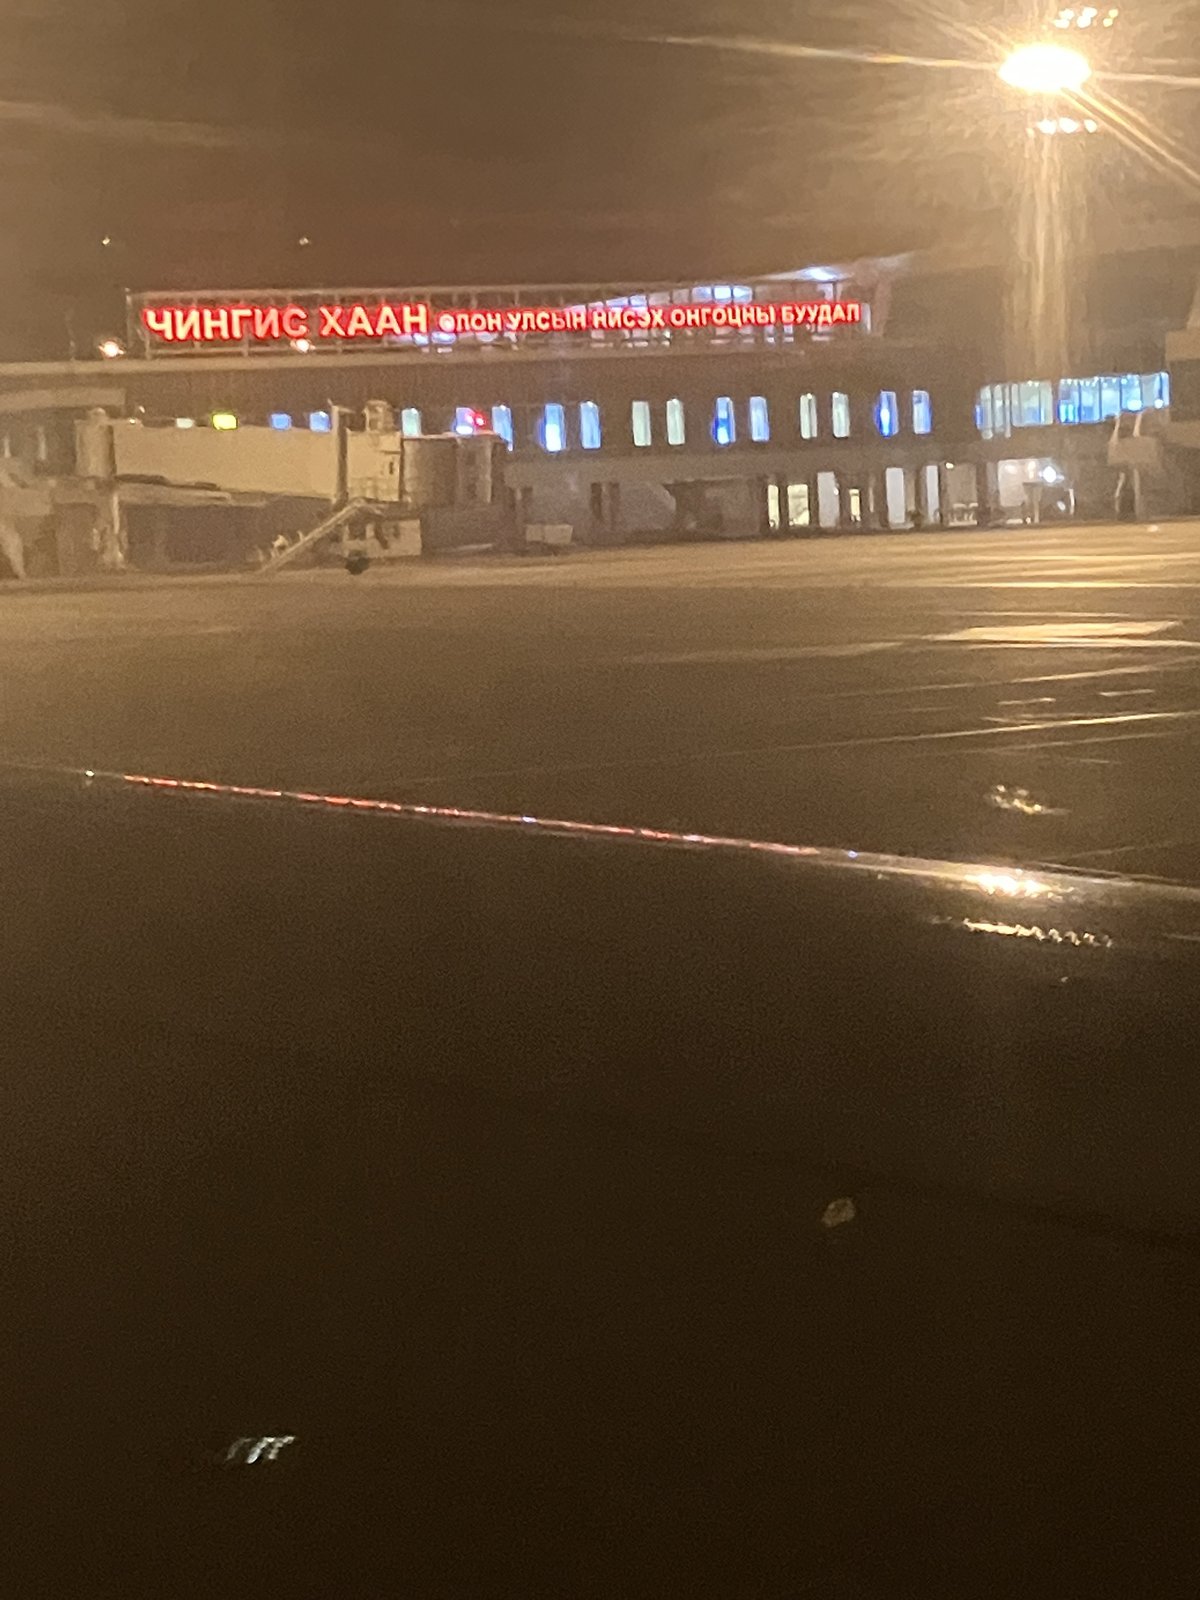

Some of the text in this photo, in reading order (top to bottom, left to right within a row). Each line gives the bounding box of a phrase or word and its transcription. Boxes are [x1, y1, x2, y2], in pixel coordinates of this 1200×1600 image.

[146, 306, 309, 341] ЧИНГИС
[319, 304, 429, 338] ХААН
[670, 305, 776, 328] ОНГОЦНЫ
